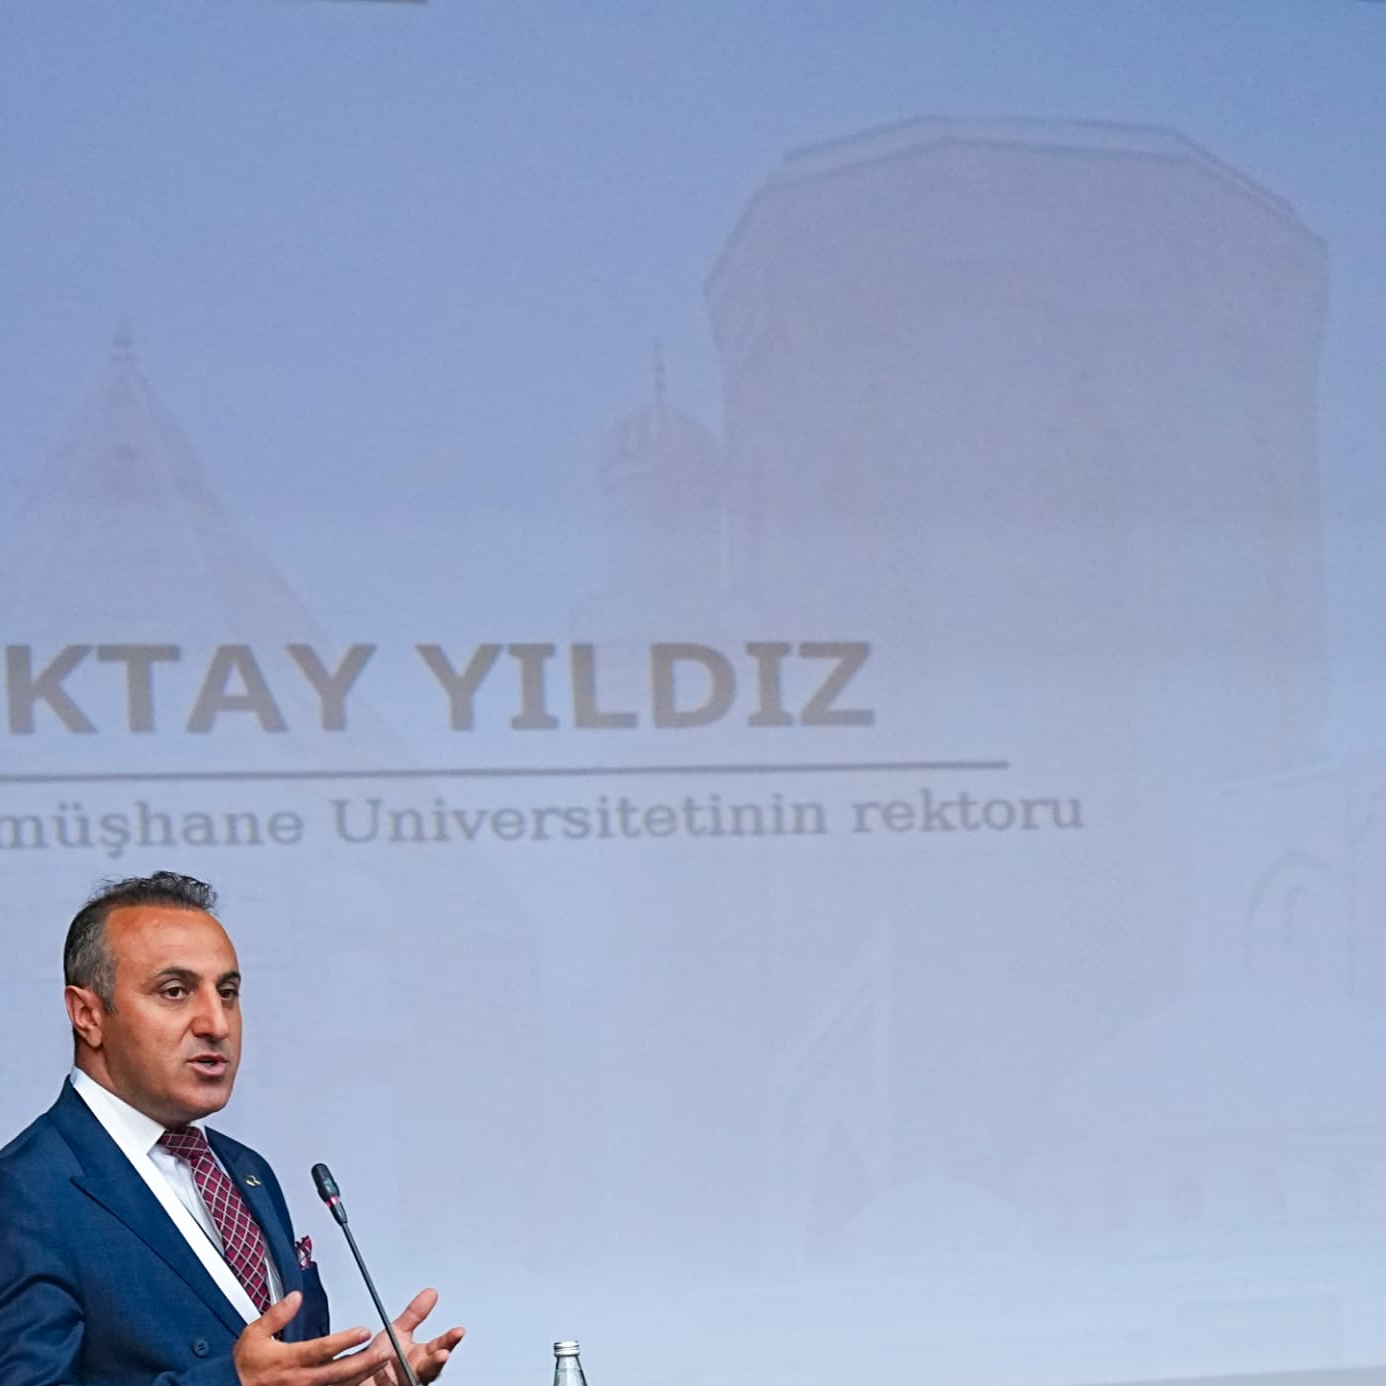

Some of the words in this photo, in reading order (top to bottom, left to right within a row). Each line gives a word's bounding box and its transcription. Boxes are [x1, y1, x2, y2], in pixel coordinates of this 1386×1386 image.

[415, 641, 875, 732] YILDIZ
[330, 794, 829, 844] Universitetinin
[851, 788, 1085, 833] rektoru
